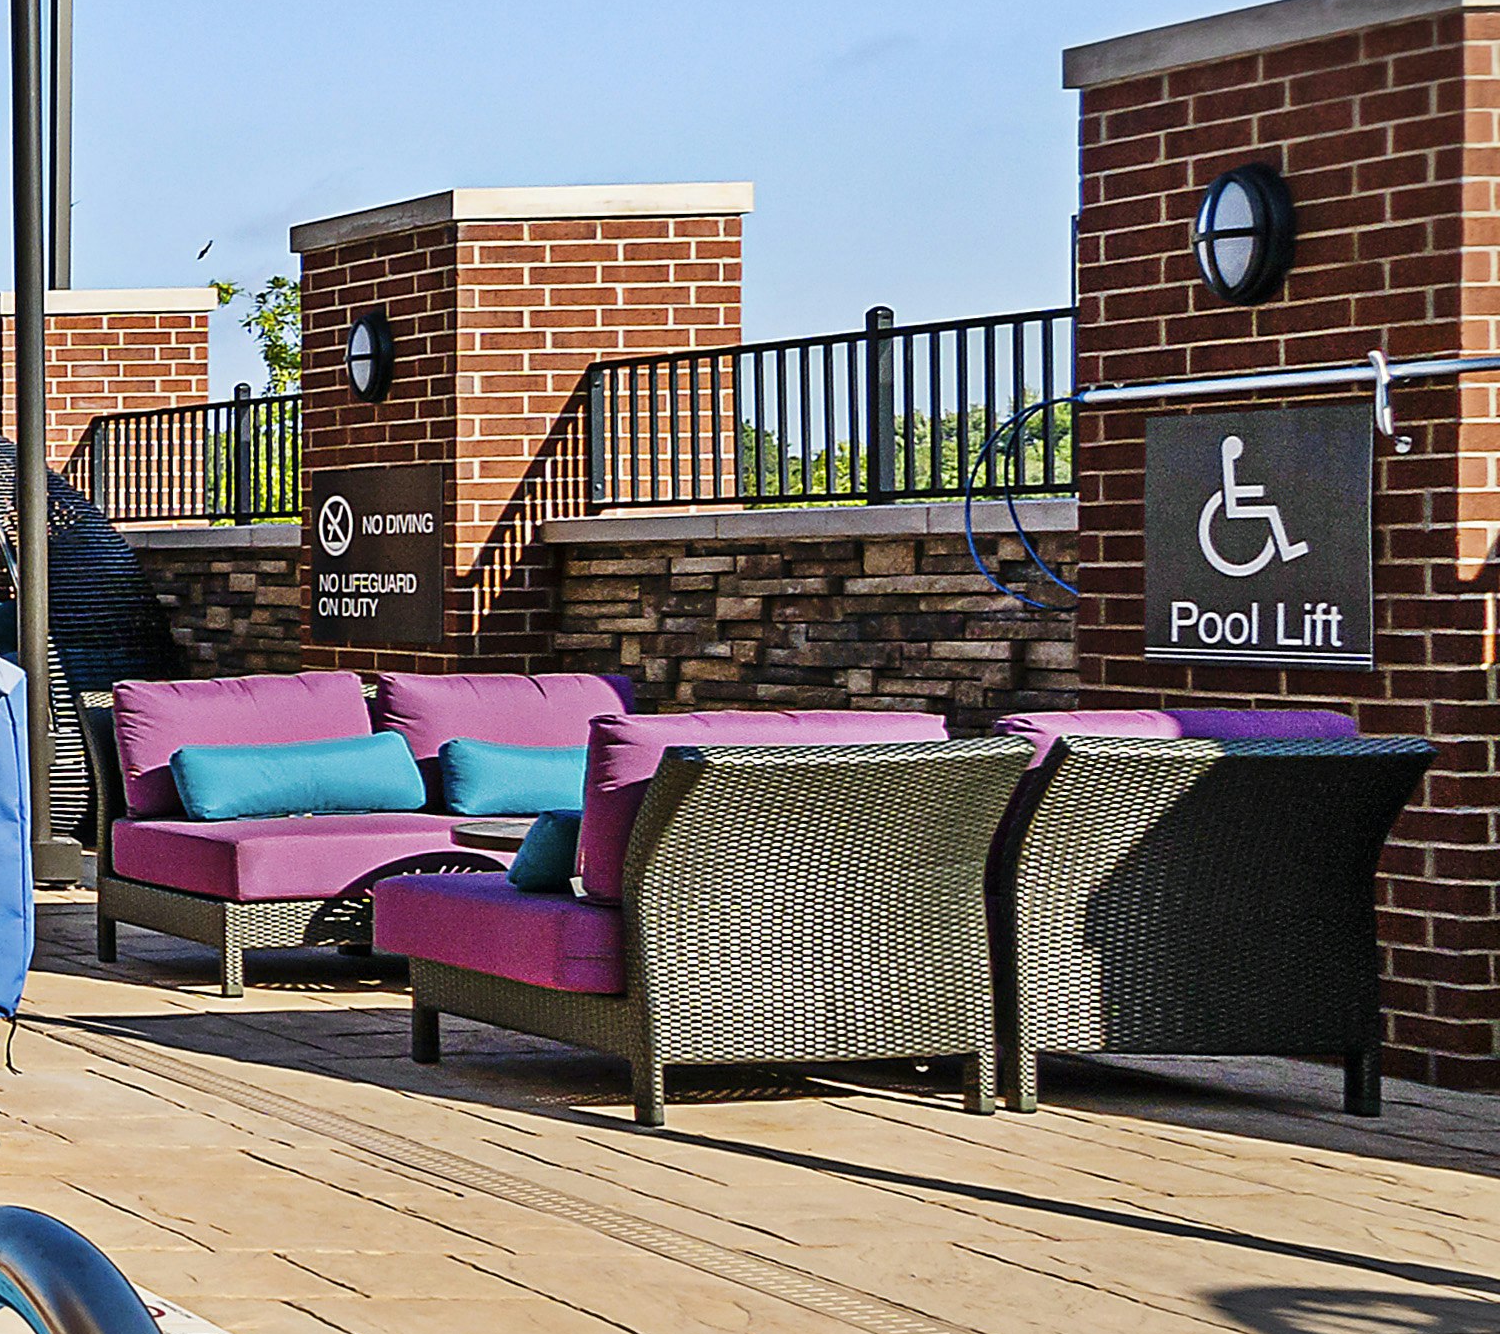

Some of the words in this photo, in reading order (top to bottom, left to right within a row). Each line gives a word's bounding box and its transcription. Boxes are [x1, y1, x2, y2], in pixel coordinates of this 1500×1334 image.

[362, 515, 383, 535] NO
[386, 513, 434, 535] DIVING
[319, 573, 339, 593] NO
[342, 573, 417, 594] LIFEGUARD
[318, 597, 338, 616] ON
[342, 598, 379, 617] DUTY
[1170, 601, 1260, 645] Pool
[1277, 602, 1344, 647] Lift
